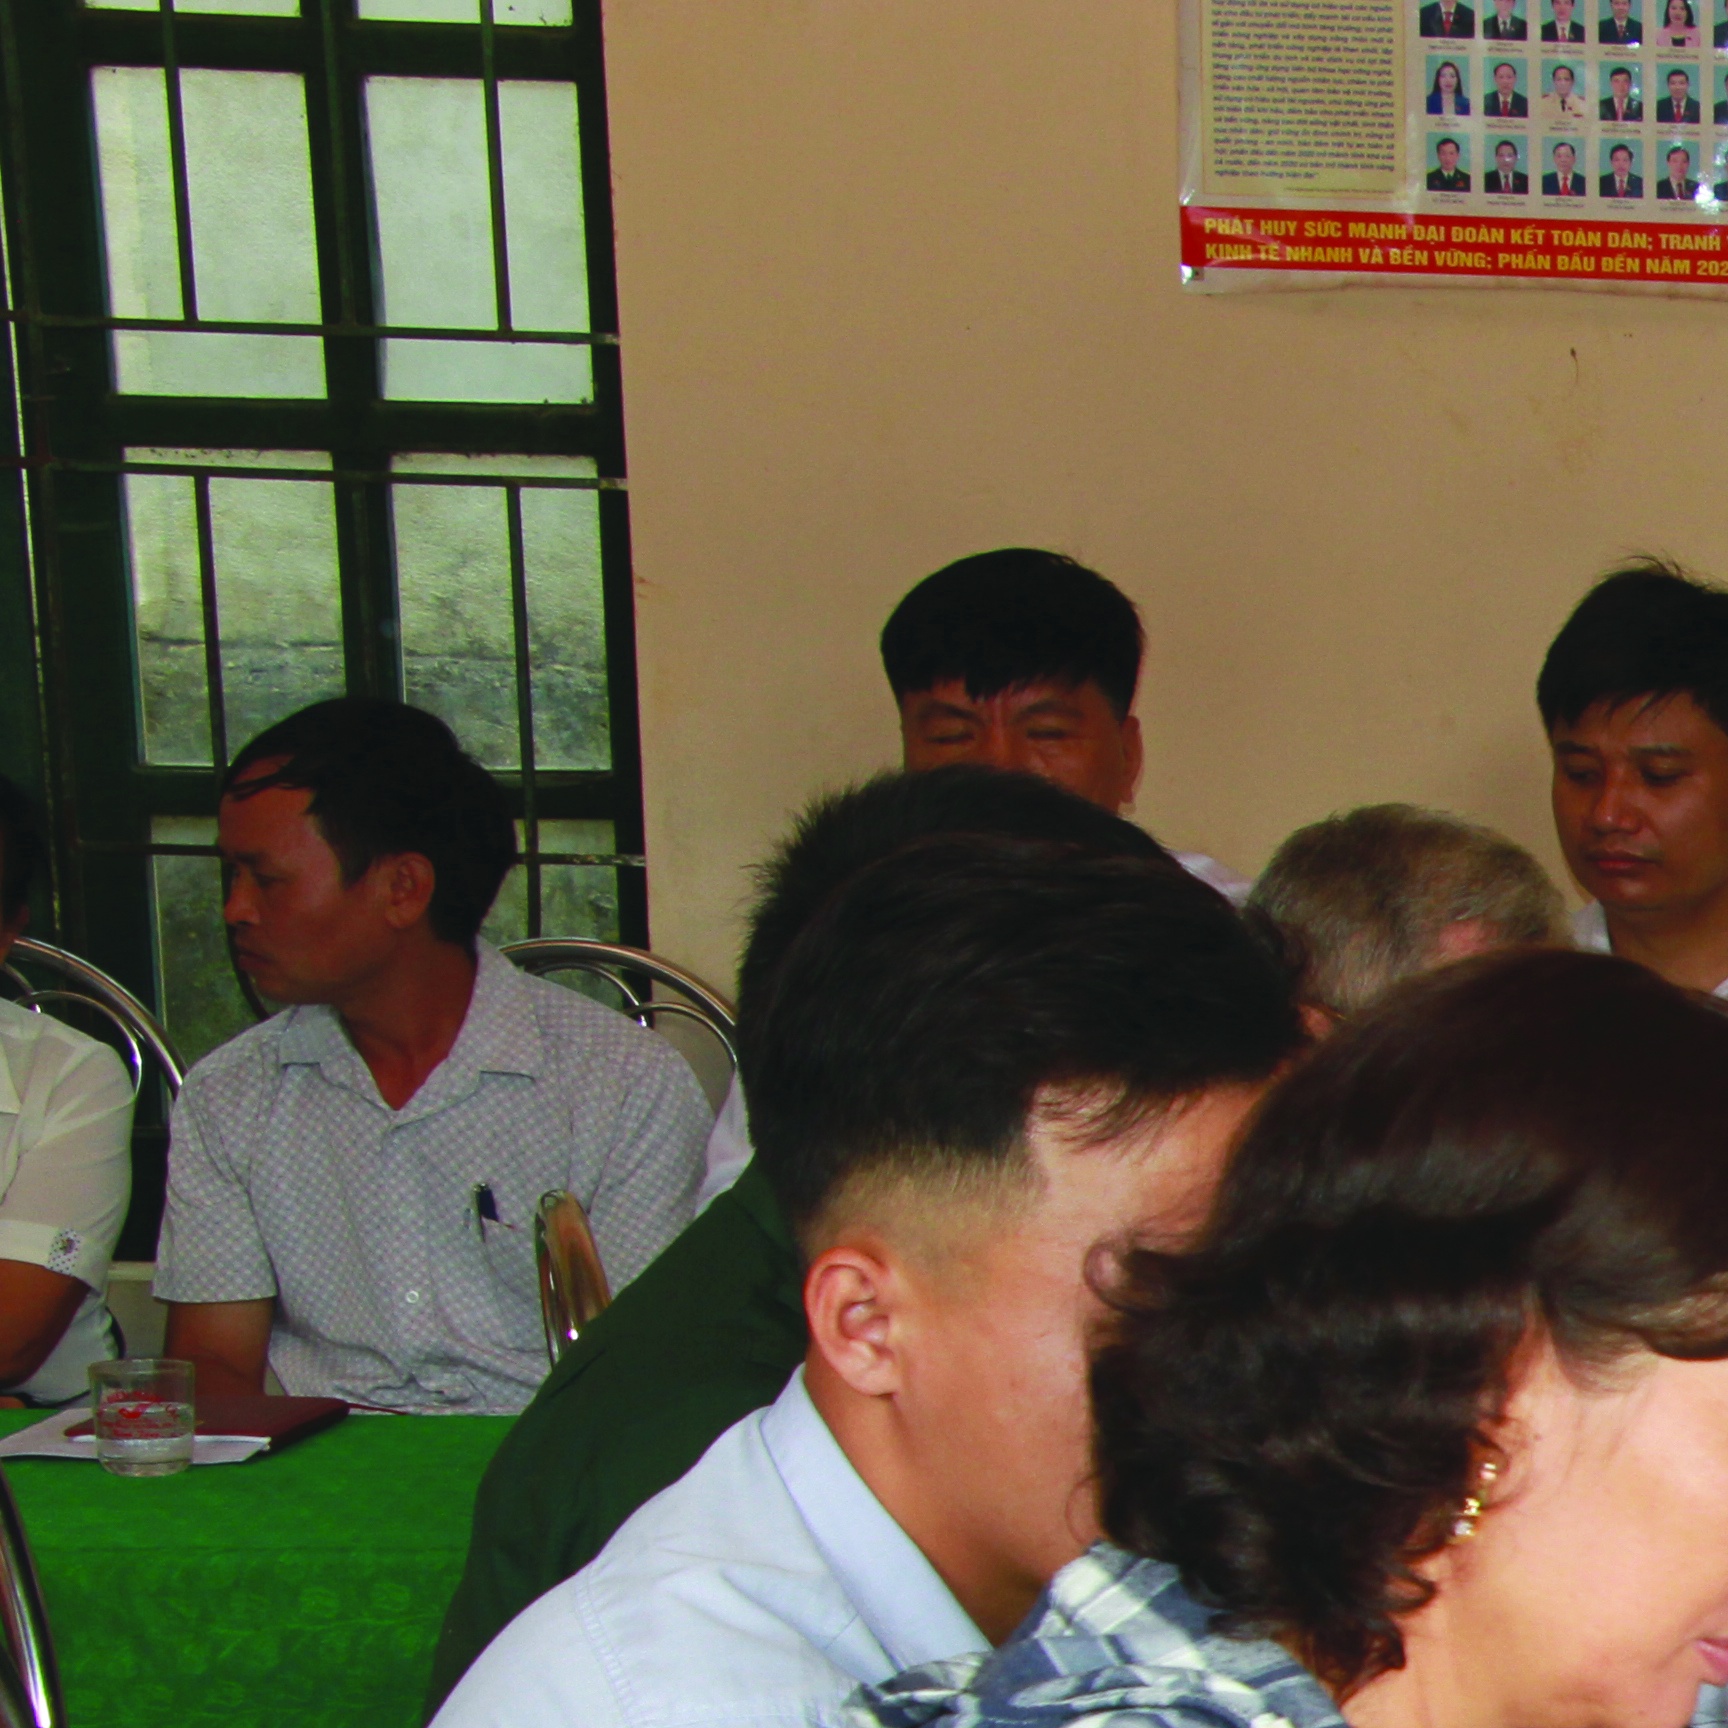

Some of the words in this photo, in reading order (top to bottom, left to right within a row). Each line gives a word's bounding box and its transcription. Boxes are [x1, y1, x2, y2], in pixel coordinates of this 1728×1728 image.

[1204, 216, 1253, 235] PHÁT
[1260, 220, 1297, 236] HUY
[1304, 218, 1342, 237] SỨC
[1349, 222, 1406, 242] MẠNH
[1412, 225, 1445, 244] ĐẠI
[1451, 224, 1504, 244] ĐOÀN
[1511, 224, 1545, 245] KẾT
[1551, 228, 1601, 247] TOÀN
[1607, 229, 1653, 250] DÂN;
[1659, 233, 1721, 251] TRANH
[1205, 243, 1252, 260] KINH
[1259, 241, 1281, 261] TẾ
[1286, 246, 1352, 263] NHANH
[1359, 244, 1383, 263] VÀ
[1390, 245, 1429, 266] BỀN
[1434, 247, 1492, 269] VỮNG;
[1498, 249, 1550, 270] PHẤN
[1557, 251, 1595, 271] ĐẤU
[1602, 252, 1640, 273] ĐẾN
[1646, 255, 1690, 275] NĂM
